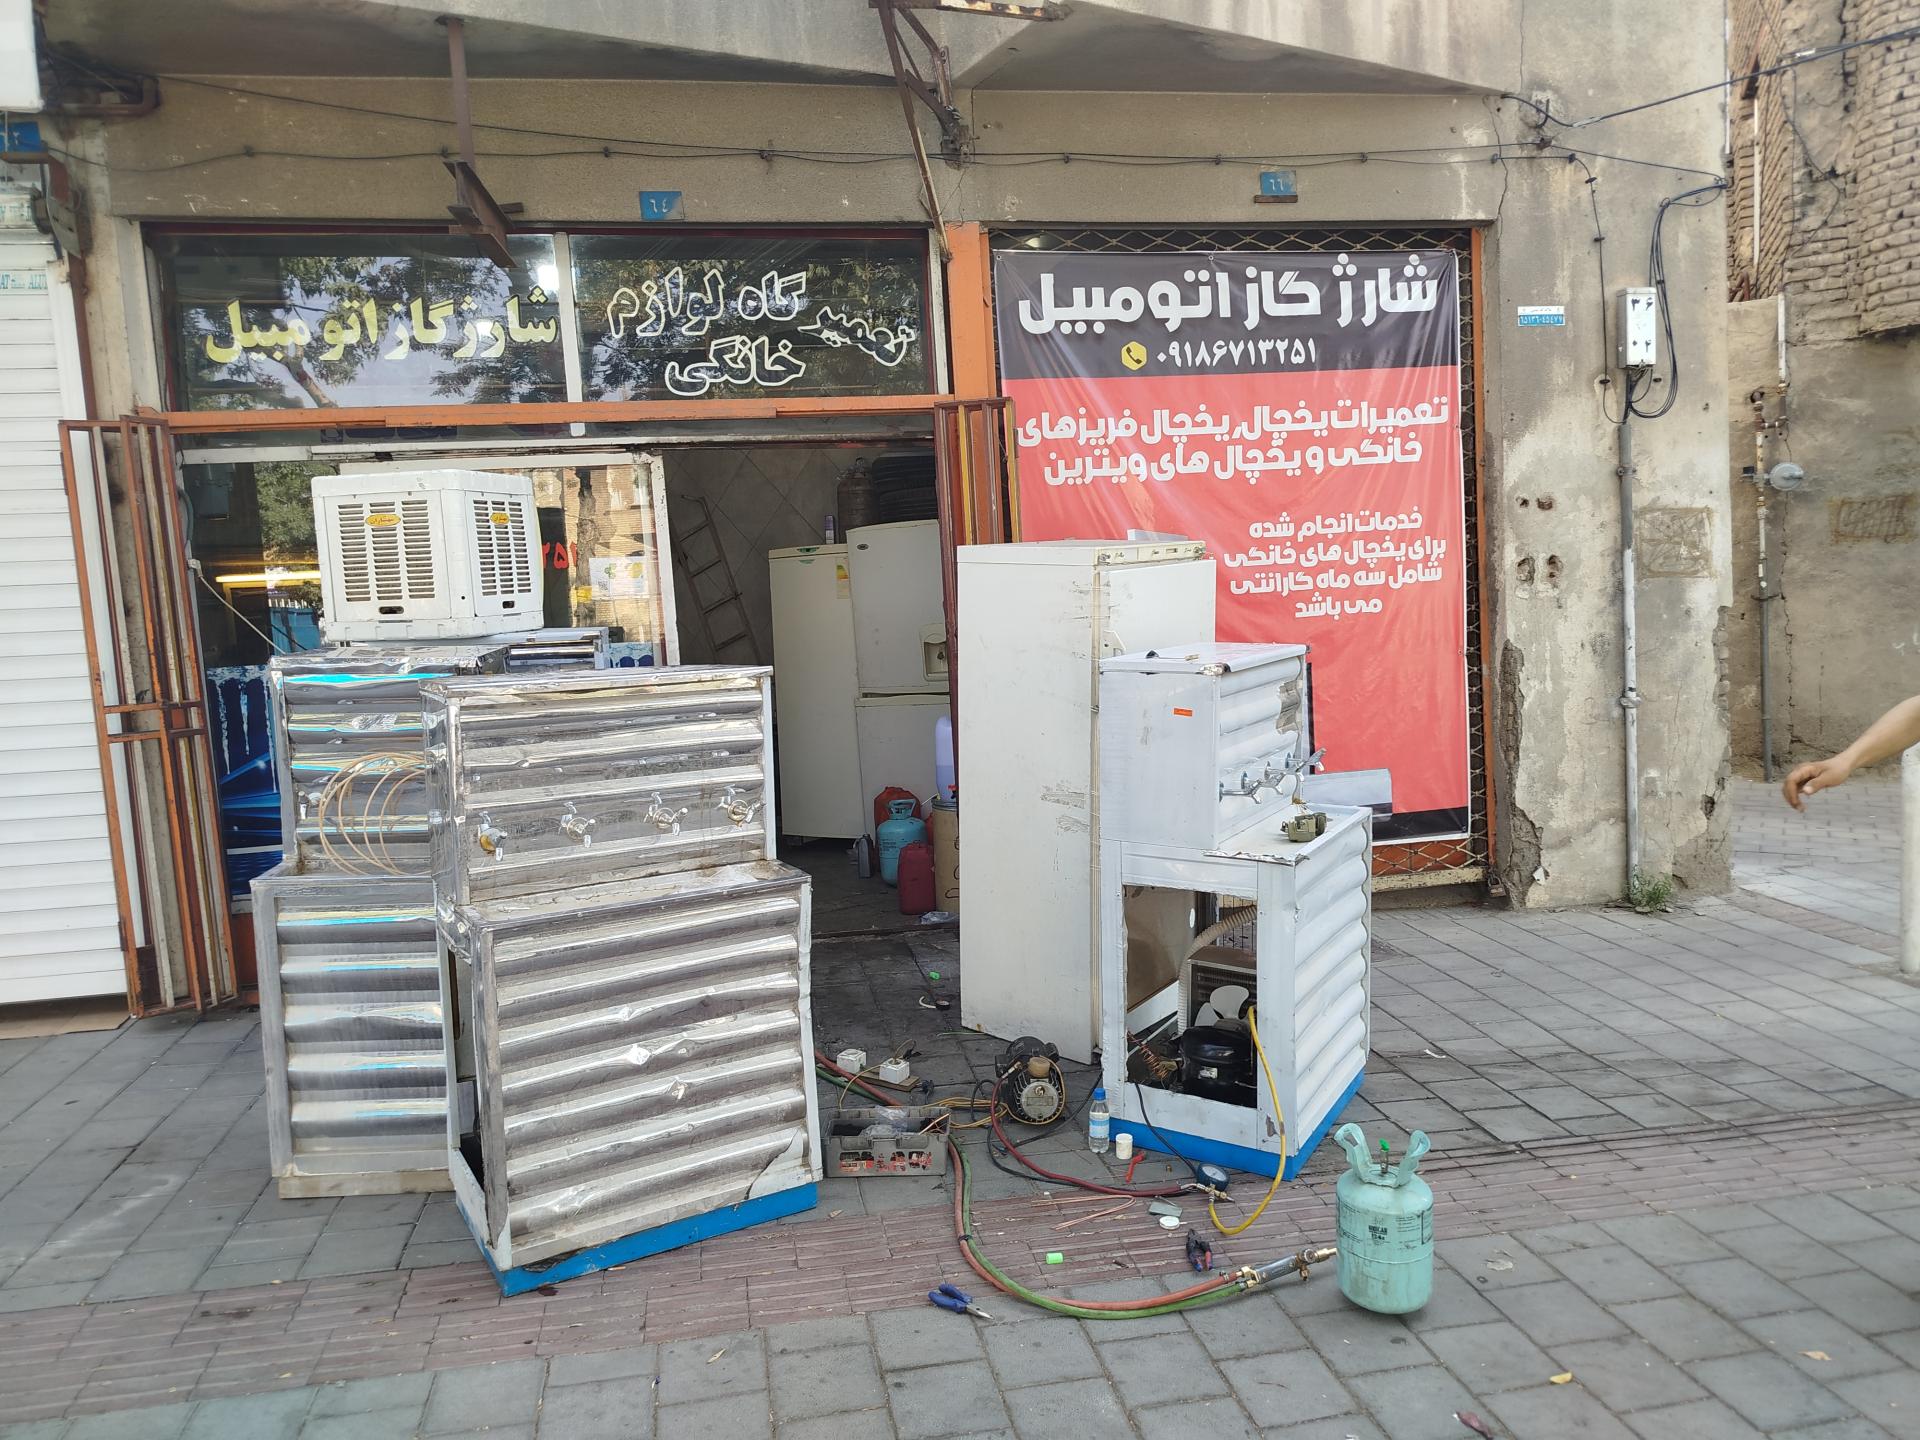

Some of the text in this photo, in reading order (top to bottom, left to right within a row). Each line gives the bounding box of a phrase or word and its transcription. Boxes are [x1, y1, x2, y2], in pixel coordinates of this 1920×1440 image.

[607, 266, 724, 339] لوازم
[1018, 253, 1438, 335] شارژ گاز اتومبیل
[384, 296, 454, 361] گاز
[453, 285, 558, 358] شارژ
[665, 335, 807, 396] خانگی
[1157, 337, 1316, 368] ۰۹۱۸۶۷۱۳۲۵۱
[1141, 404, 1229, 446] یخچال
[1330, 396, 1449, 435] تعمیرات
[1044, 432, 1423, 486] خانگی و یخچال های ویترین
[1250, 506, 1423, 542] خدمات انجام شده
[1224, 535, 1447, 568] برای یخچال های خانگی
[1316, 568, 1350, 589] ماه
[1354, 568, 1386, 586] سه
[1388, 560, 1443, 589] شامل
[1295, 591, 1383, 620] می باشد
